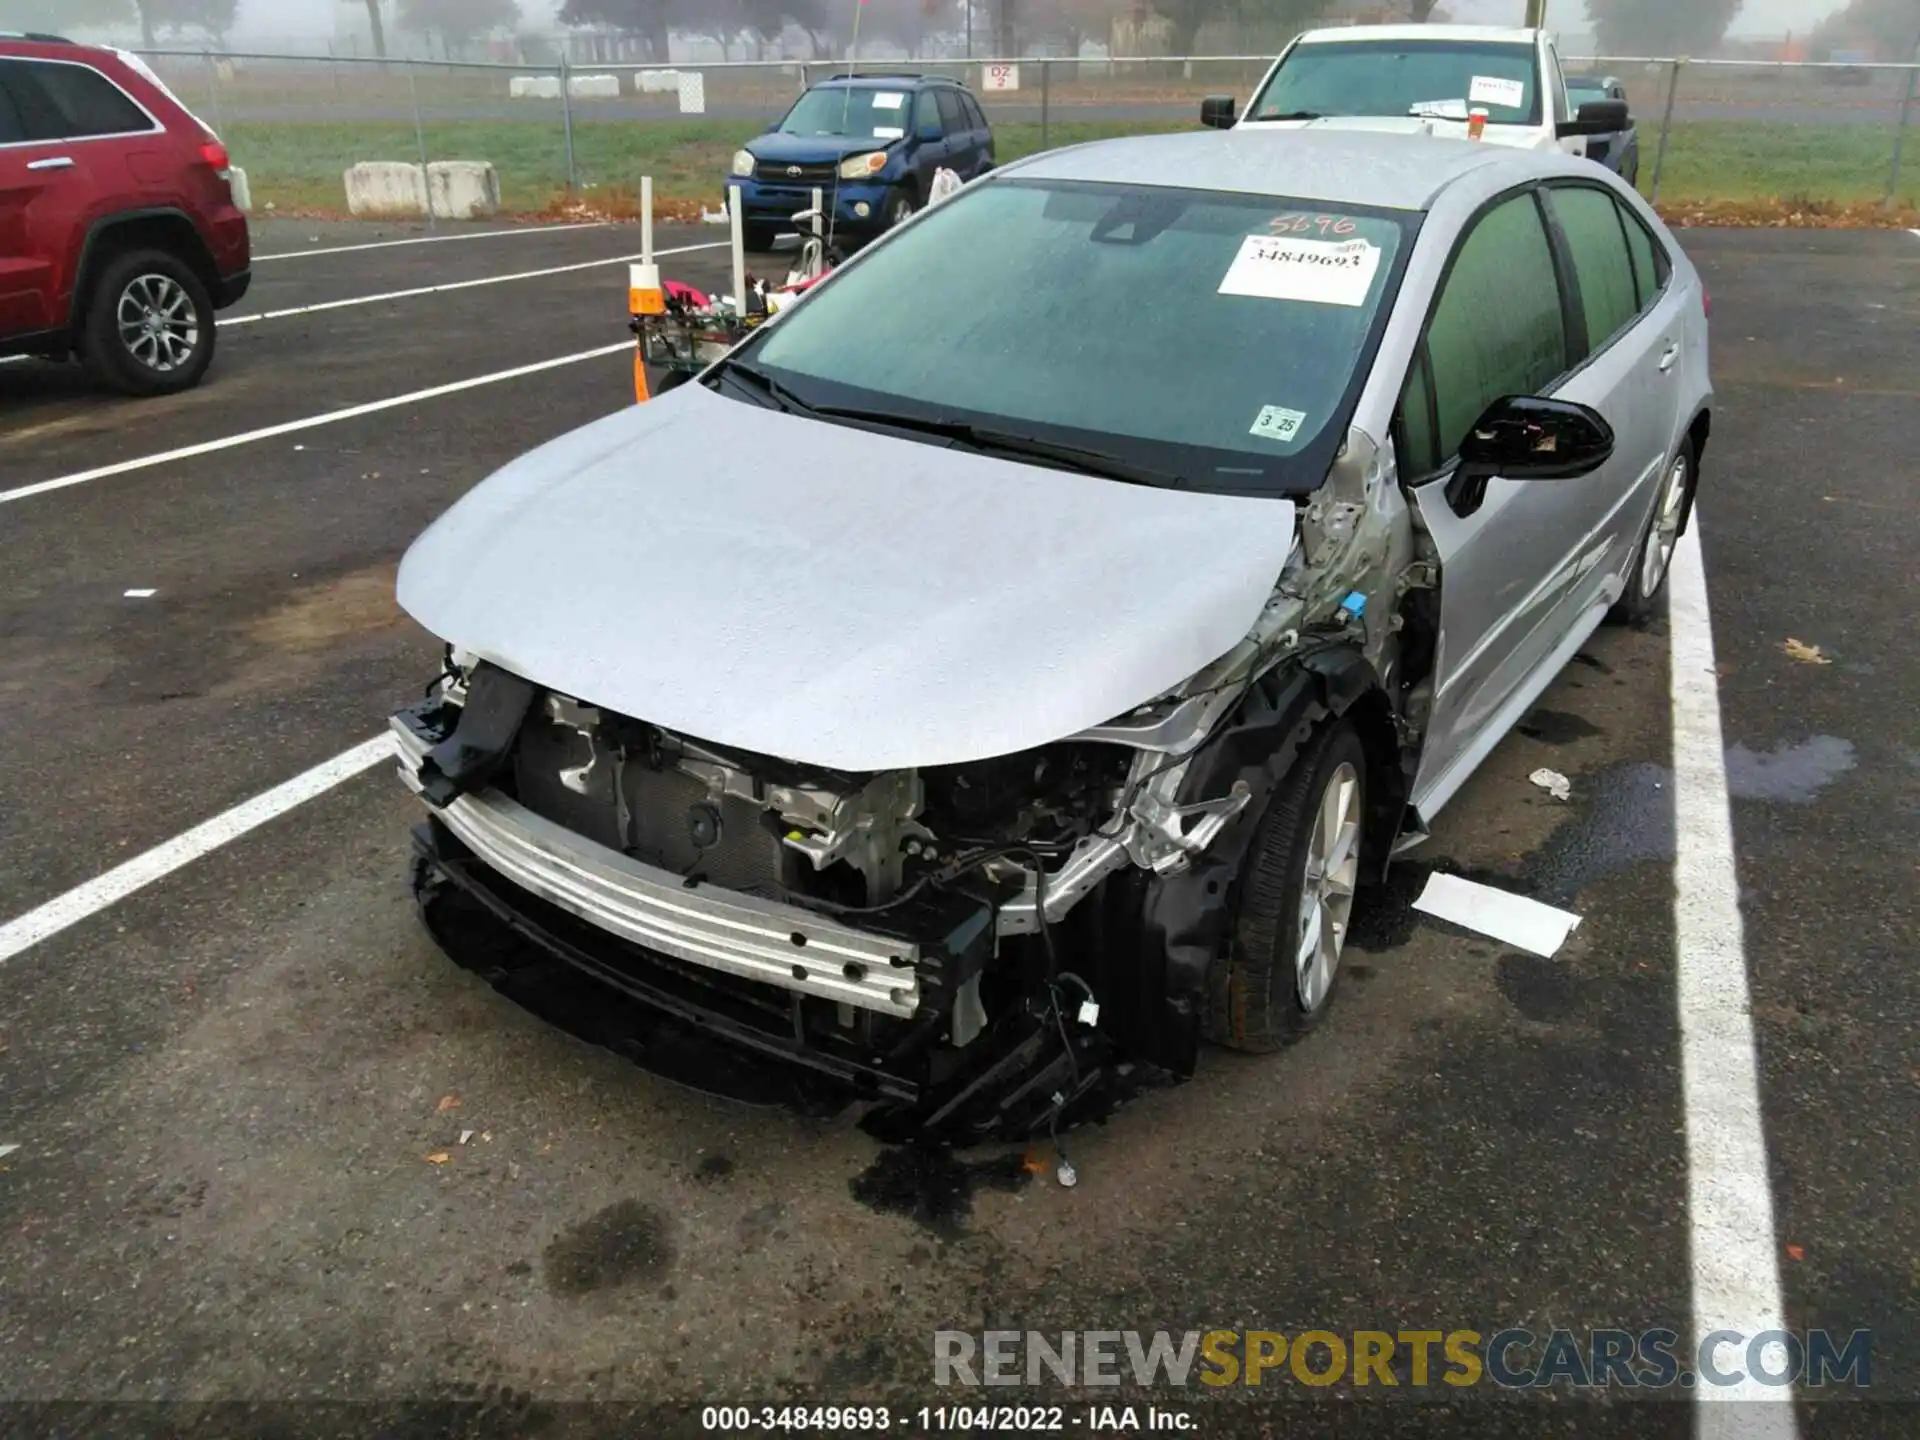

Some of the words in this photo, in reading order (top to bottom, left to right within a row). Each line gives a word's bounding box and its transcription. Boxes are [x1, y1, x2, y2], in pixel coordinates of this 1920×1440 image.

[1250, 249, 1361, 269] 34849693
[1261, 415, 1272, 426] 3
[1277, 419, 1295, 432] 25
